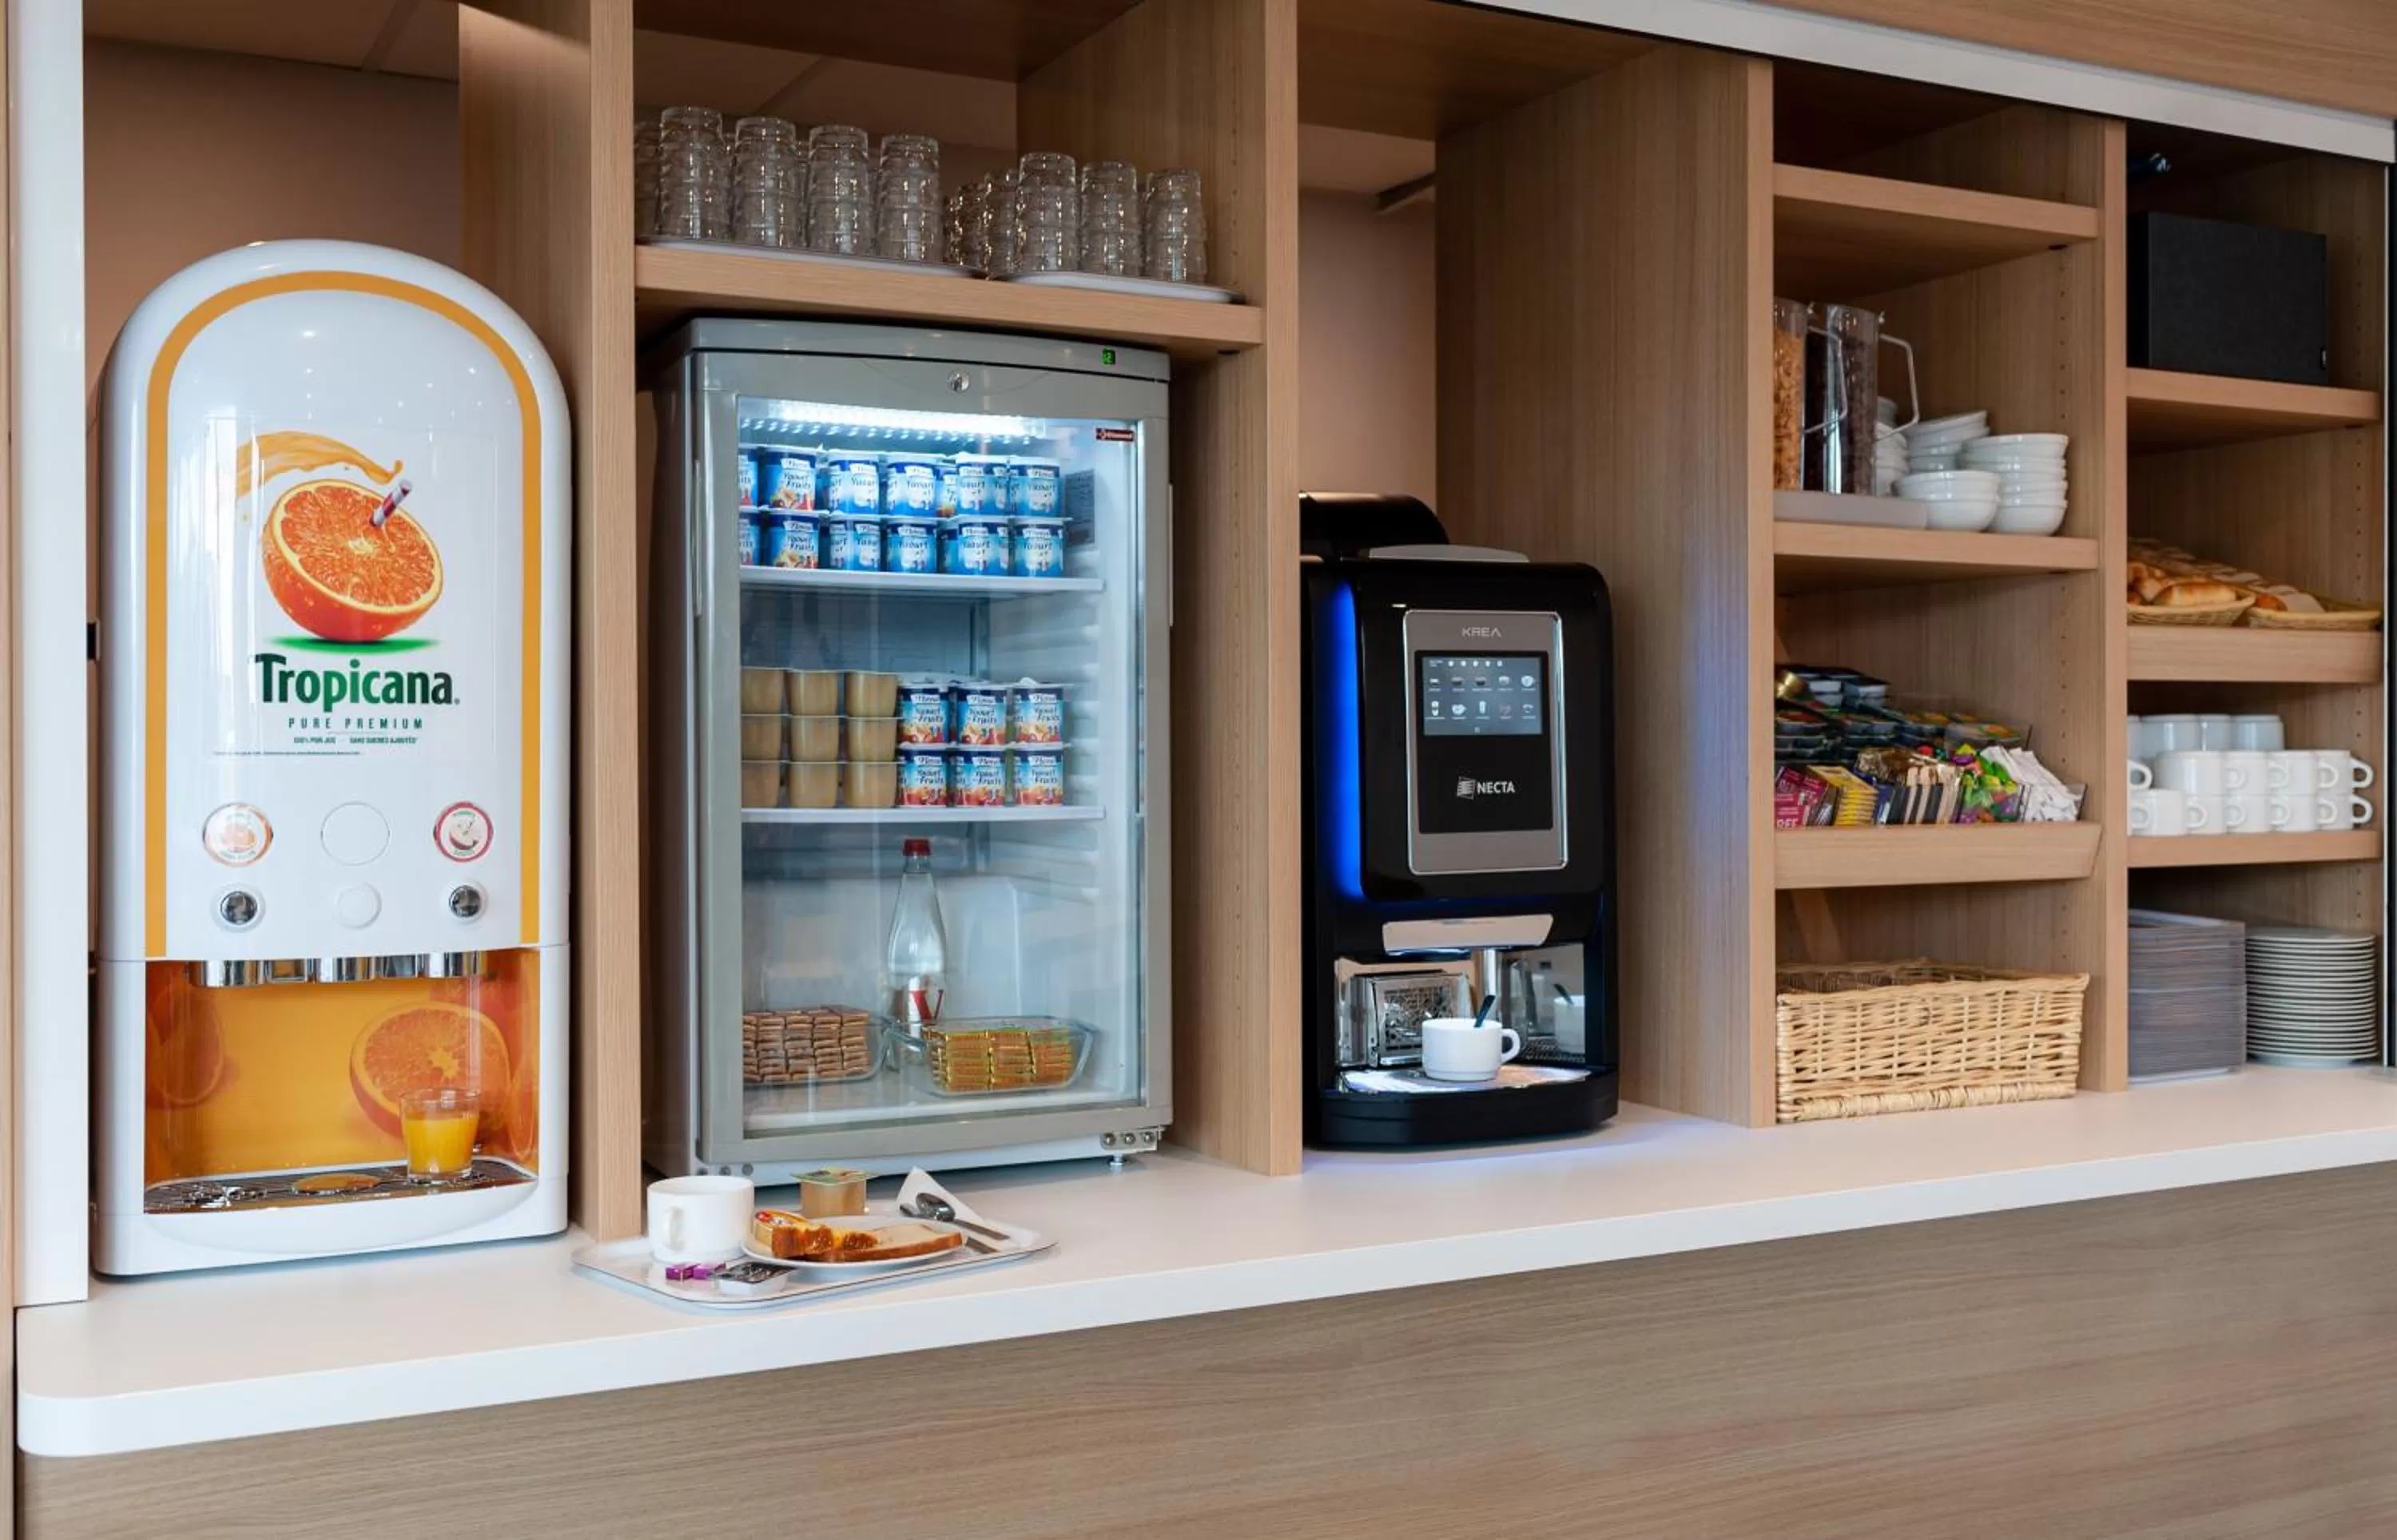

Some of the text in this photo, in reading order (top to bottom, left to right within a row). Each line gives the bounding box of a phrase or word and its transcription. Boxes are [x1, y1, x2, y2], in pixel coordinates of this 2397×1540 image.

[1461, 628, 1501, 637] KREA
[256, 653, 453, 712] Tropicana
[288, 717, 423, 728] PURE PREMIUM
[1477, 781, 1516, 794] NECTA
